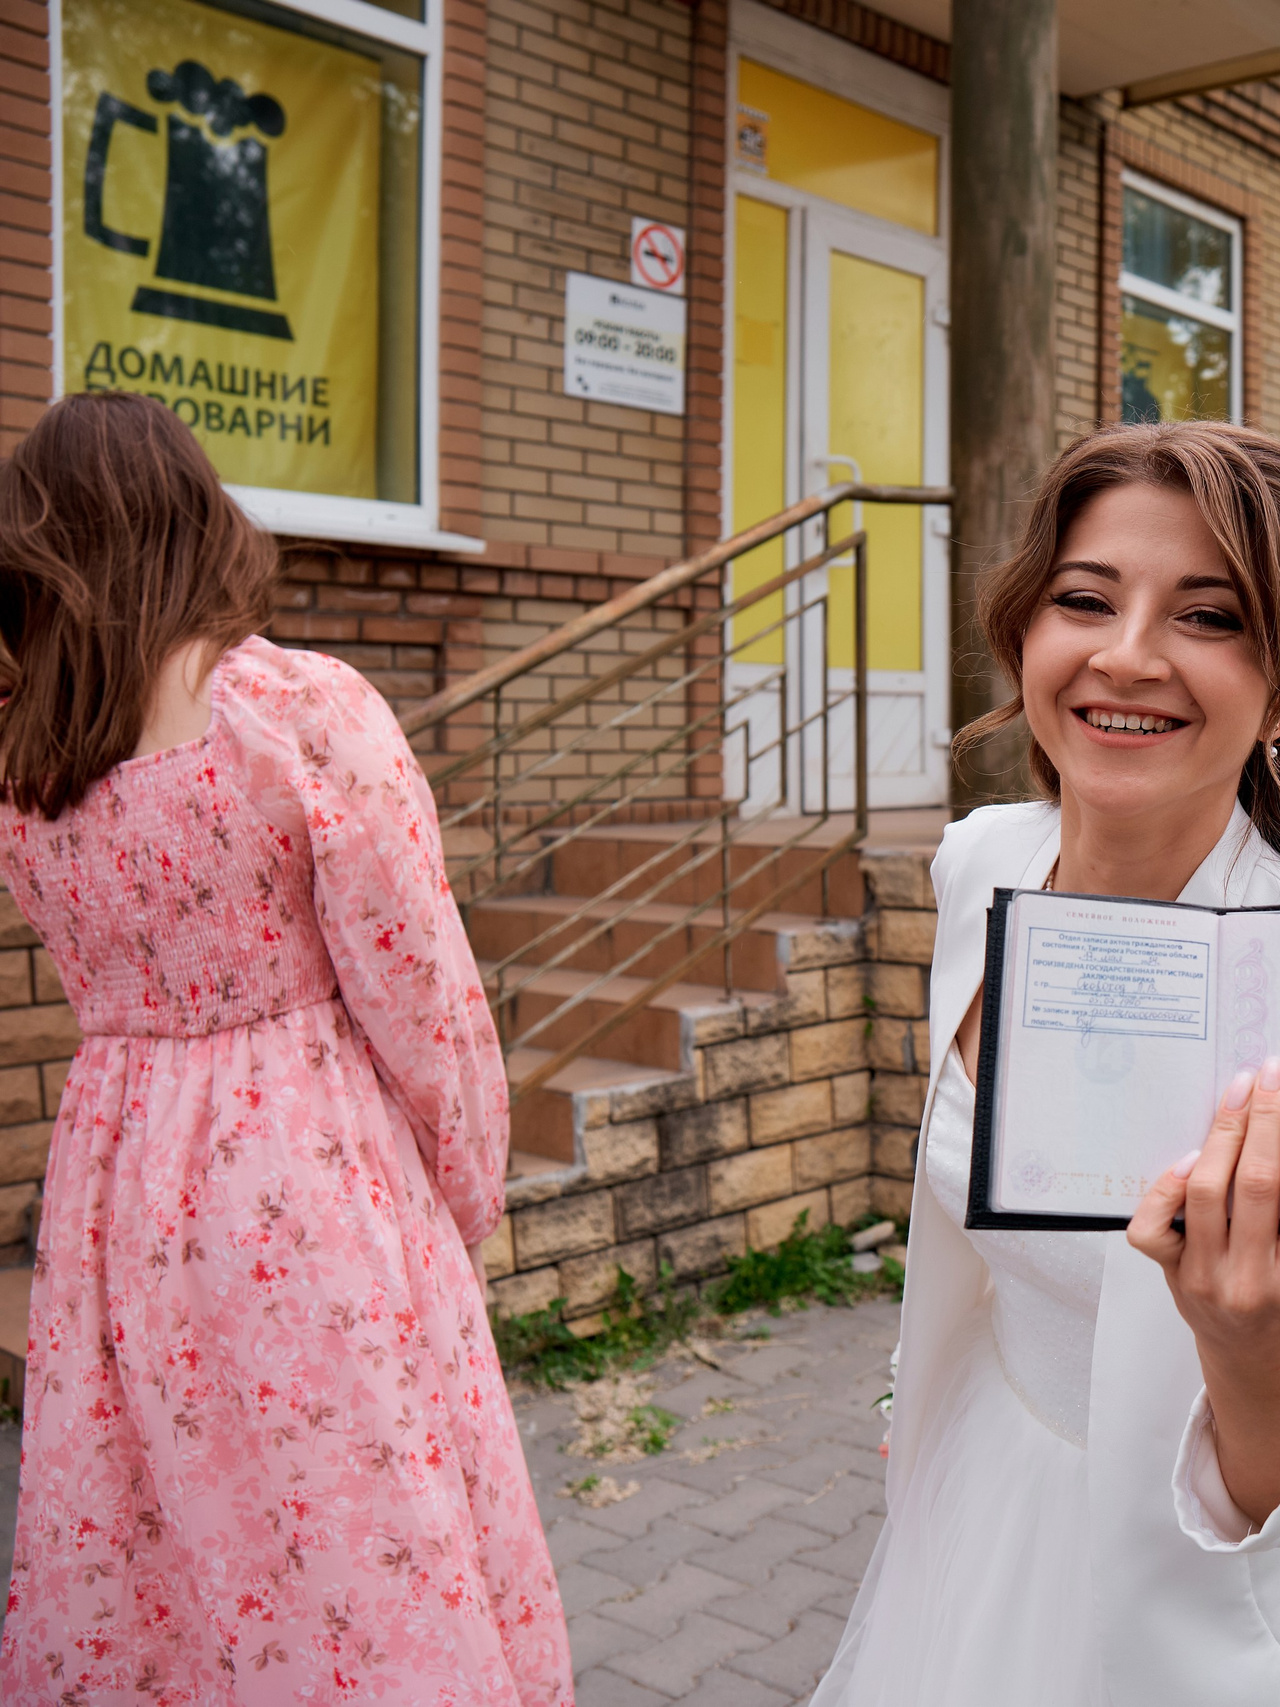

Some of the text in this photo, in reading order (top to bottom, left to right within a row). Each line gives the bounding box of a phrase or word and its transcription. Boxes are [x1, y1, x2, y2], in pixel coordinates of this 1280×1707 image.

[575, 329, 619, 351] 09:00
[635, 341, 676, 363] 20:00
[84, 341, 331, 408] ДОМАШНИЕ
[1066, 911, 1178, 926] СЕМЕЙНОЕ ПОЛОЖЕНИЕ
[1041, 941, 1080, 950] состояния
[1088, 945, 1124, 954] Таганрога
[1168, 952, 1198, 960] области
[1058, 933, 1081, 942] Отдел
[1083, 936, 1108, 944] записи
[1131, 940, 1183, 950] гражданского
[1032, 959, 1204, 979] ПРОИЗВЕДЕНА ГОСУДАРСТВЕННАЯ РЕГИСТРАЦИЯ
[1082, 972, 1156, 984] ЗАКЛЮЧЕНИЯ БРАКА
